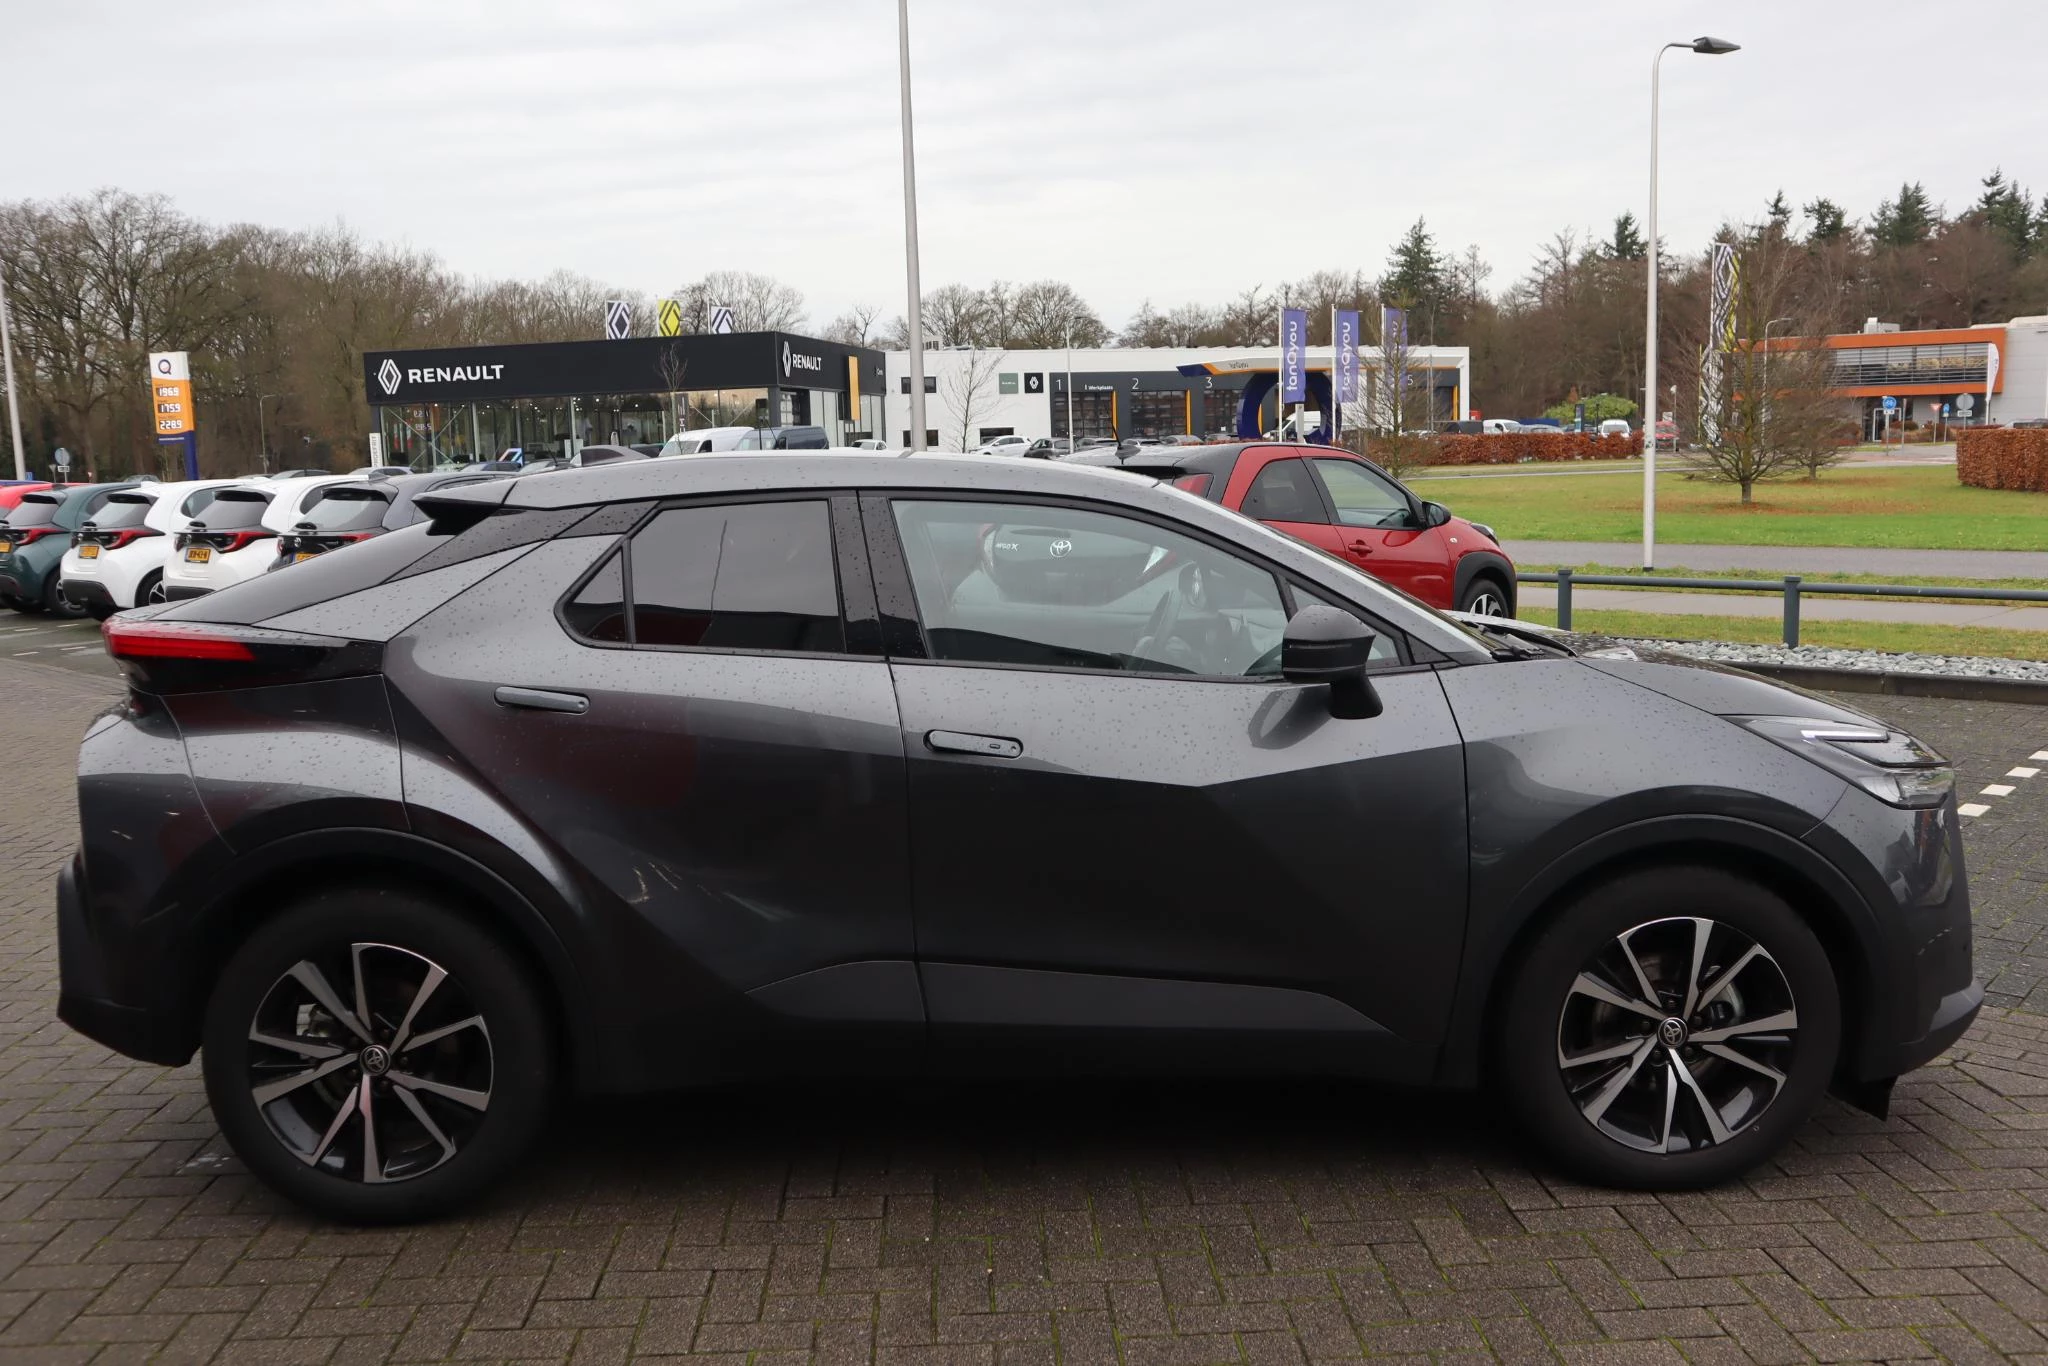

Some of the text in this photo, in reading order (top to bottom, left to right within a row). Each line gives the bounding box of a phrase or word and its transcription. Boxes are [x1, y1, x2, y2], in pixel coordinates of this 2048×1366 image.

[792, 353, 822, 371] RENAULT
[407, 364, 505, 384] RENAULT
[1055, 379, 1061, 391] 1
[1131, 377, 1140, 390] 2
[1205, 376, 1213, 389] 3
